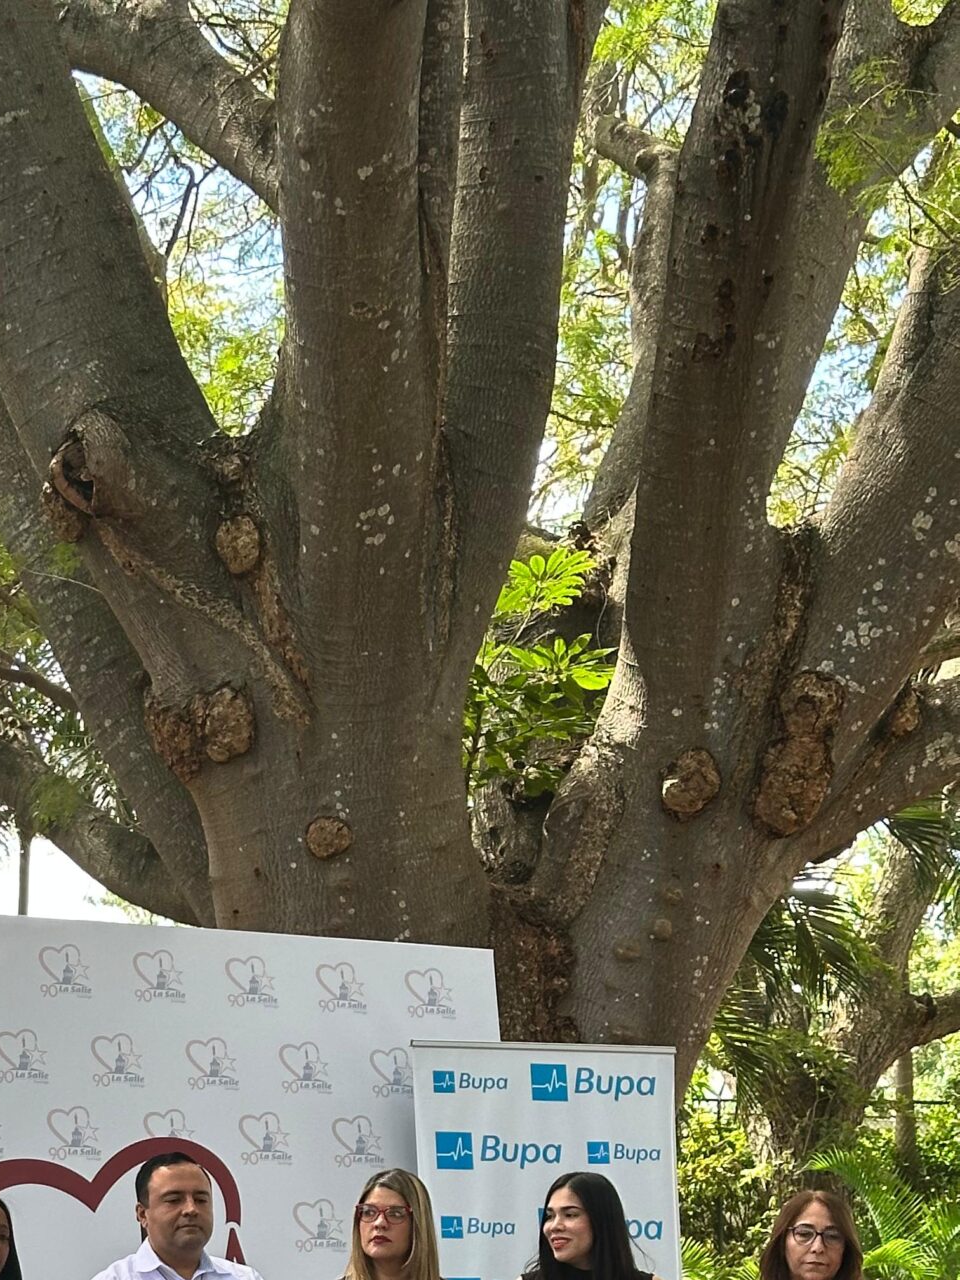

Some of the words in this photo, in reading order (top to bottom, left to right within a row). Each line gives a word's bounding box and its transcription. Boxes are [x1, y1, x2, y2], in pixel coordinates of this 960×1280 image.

[40, 984, 58, 998] 90
[72, 986, 92, 994] Salle
[134, 989, 152, 1002] 90
[153, 990, 163, 998] La
[228, 994, 245, 1007] 90
[258, 996, 278, 1004] Salle
[318, 1000, 336, 1012] 90
[408, 1006, 424, 1018] 90
[436, 1007, 456, 1015] Salle
[27, 1072, 48, 1080] Salle
[92, 1074, 110, 1087] 90
[459, 1072, 508, 1092] Bupa
[188, 1077, 206, 1090] 90
[206, 1078, 216, 1086] La
[282, 1080, 299, 1094] 90
[312, 1082, 332, 1090] Salle
[574, 1067, 656, 1101] Bupa
[372, 1085, 390, 1098] 90
[48, 1147, 66, 1160] 90
[68, 1148, 78, 1156] La
[80, 1148, 102, 1156] Salle
[240, 1152, 258, 1165] 90
[480, 1135, 562, 1169] Bupa
[614, 1144, 661, 1164] Bupa
[334, 1155, 352, 1168] 90
[364, 1156, 384, 1164] Salle
[467, 1218, 516, 1238] Bupa
[296, 1240, 313, 1252] 90
